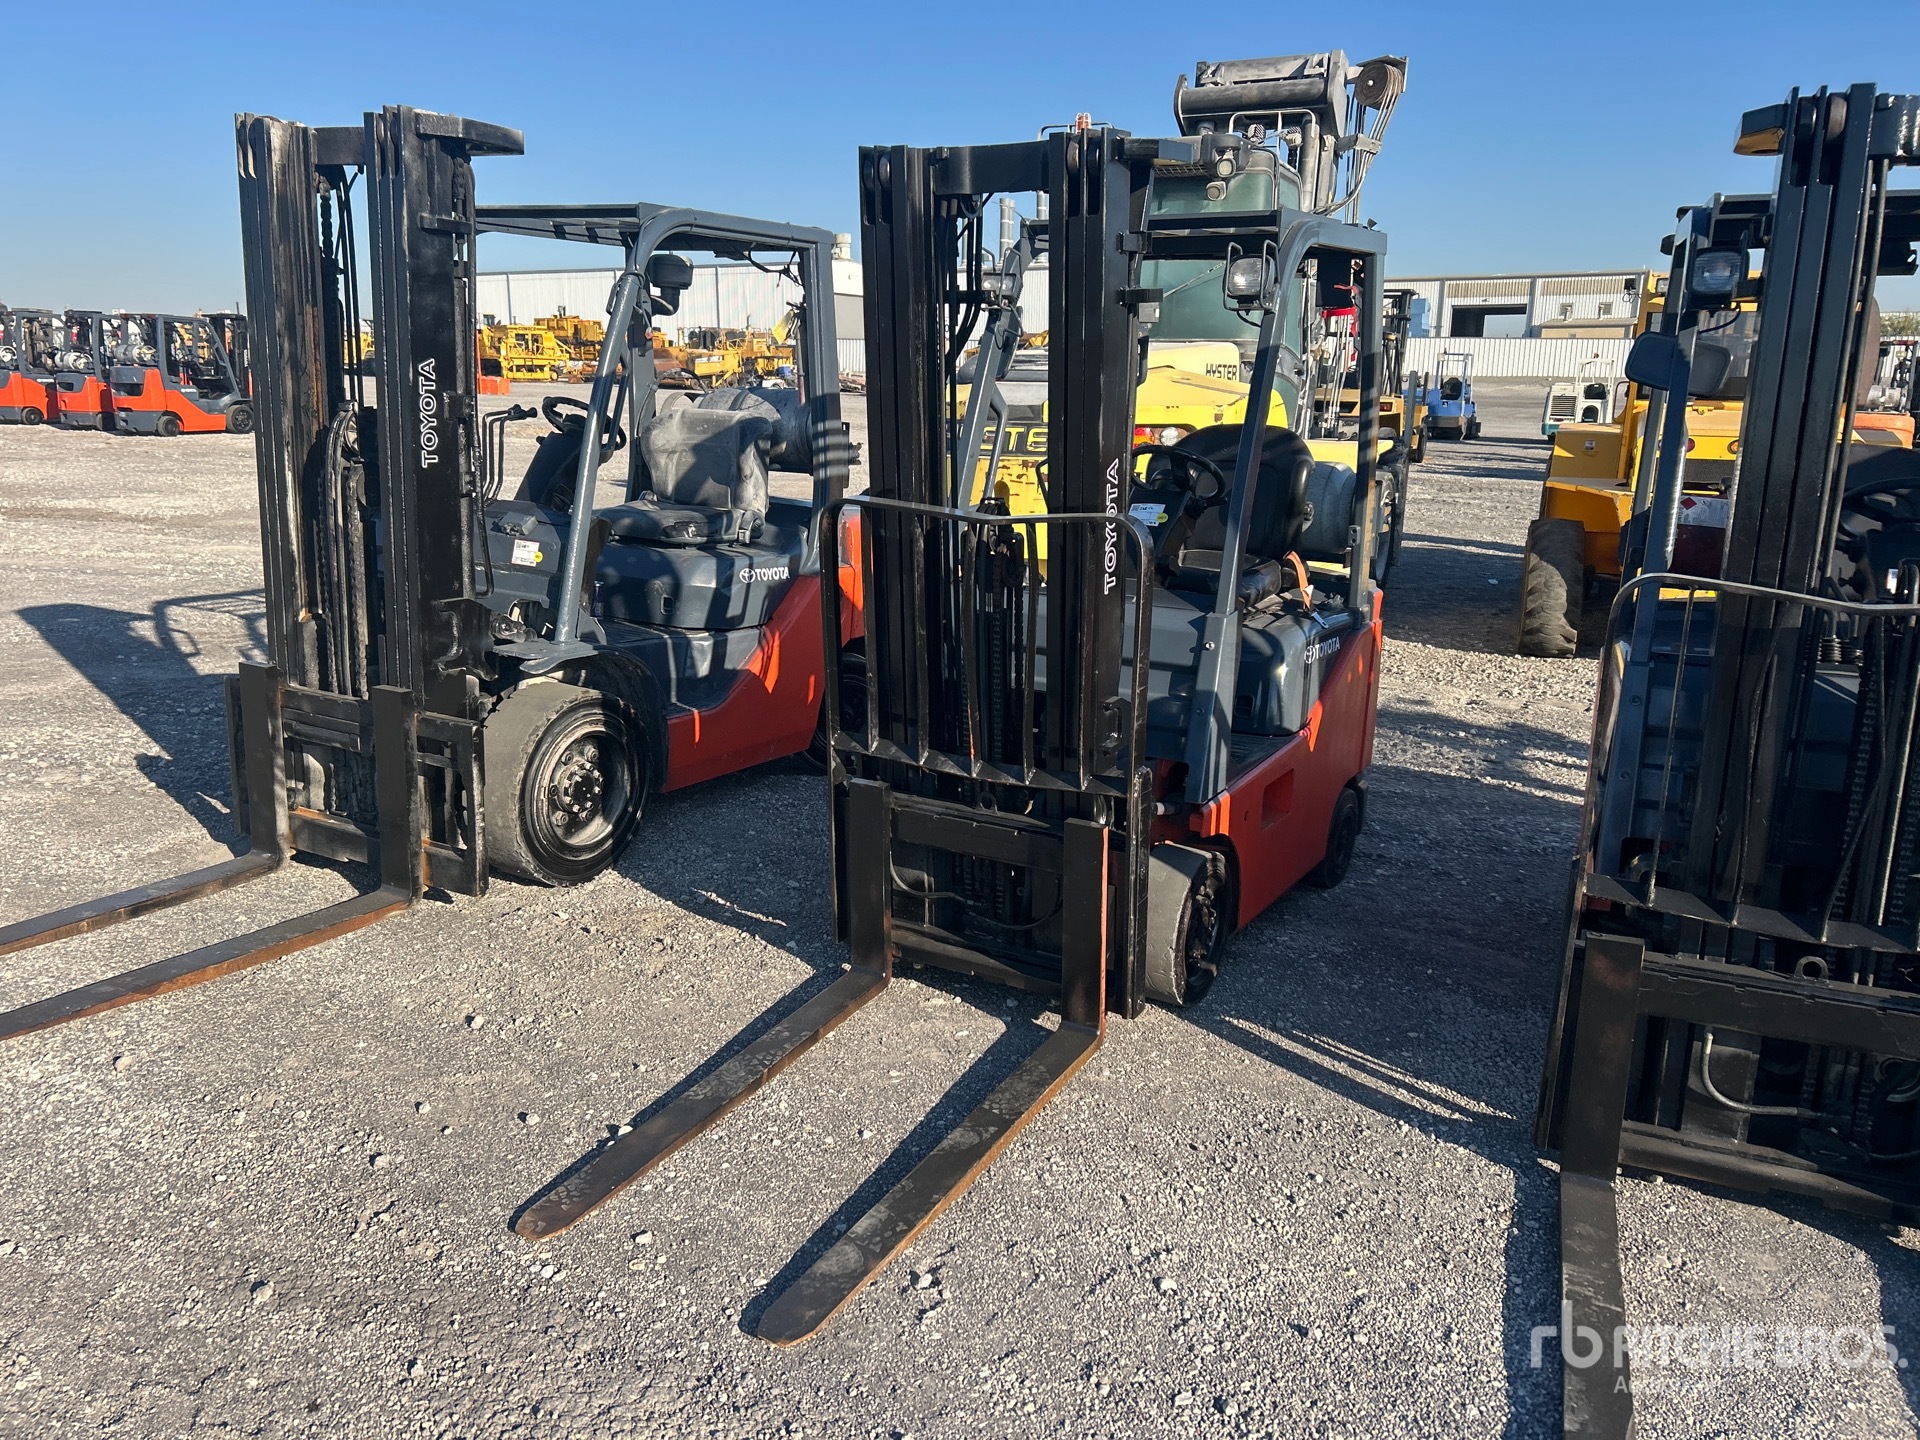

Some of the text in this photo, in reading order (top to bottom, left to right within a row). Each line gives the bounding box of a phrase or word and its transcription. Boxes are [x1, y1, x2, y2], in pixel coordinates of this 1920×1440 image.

[1205, 362, 1237, 381] HYSTER
[419, 358, 438, 468] TOYOTA
[1104, 458, 1119, 595] TOYOTA
[755, 566, 791, 581] TOYOTA
[1315, 636, 1340, 660] TOYOTA
